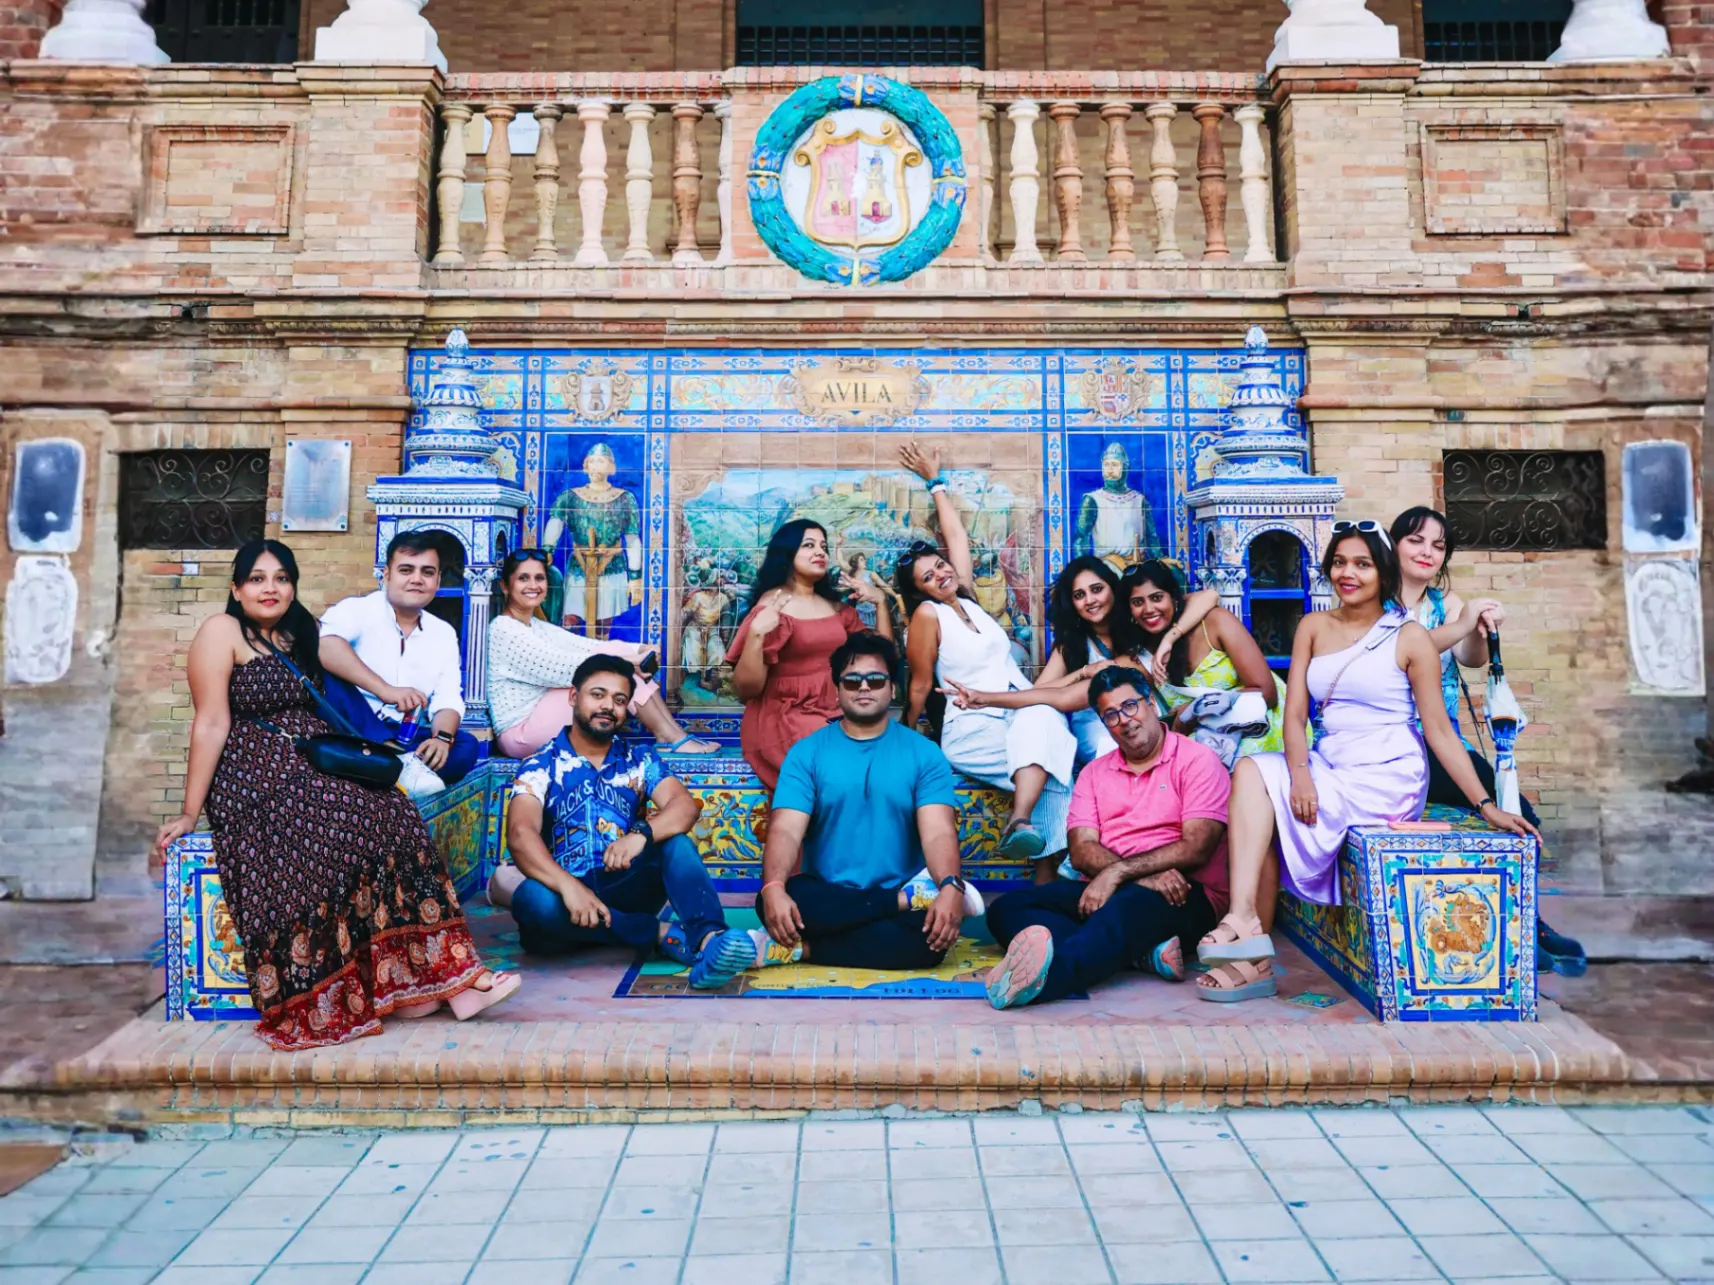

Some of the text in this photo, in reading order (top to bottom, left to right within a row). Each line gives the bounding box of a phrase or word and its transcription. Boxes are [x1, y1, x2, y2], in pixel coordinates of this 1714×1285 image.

[821, 382, 892, 403] AVILA
[554, 779, 631, 822] JACK & JONES
